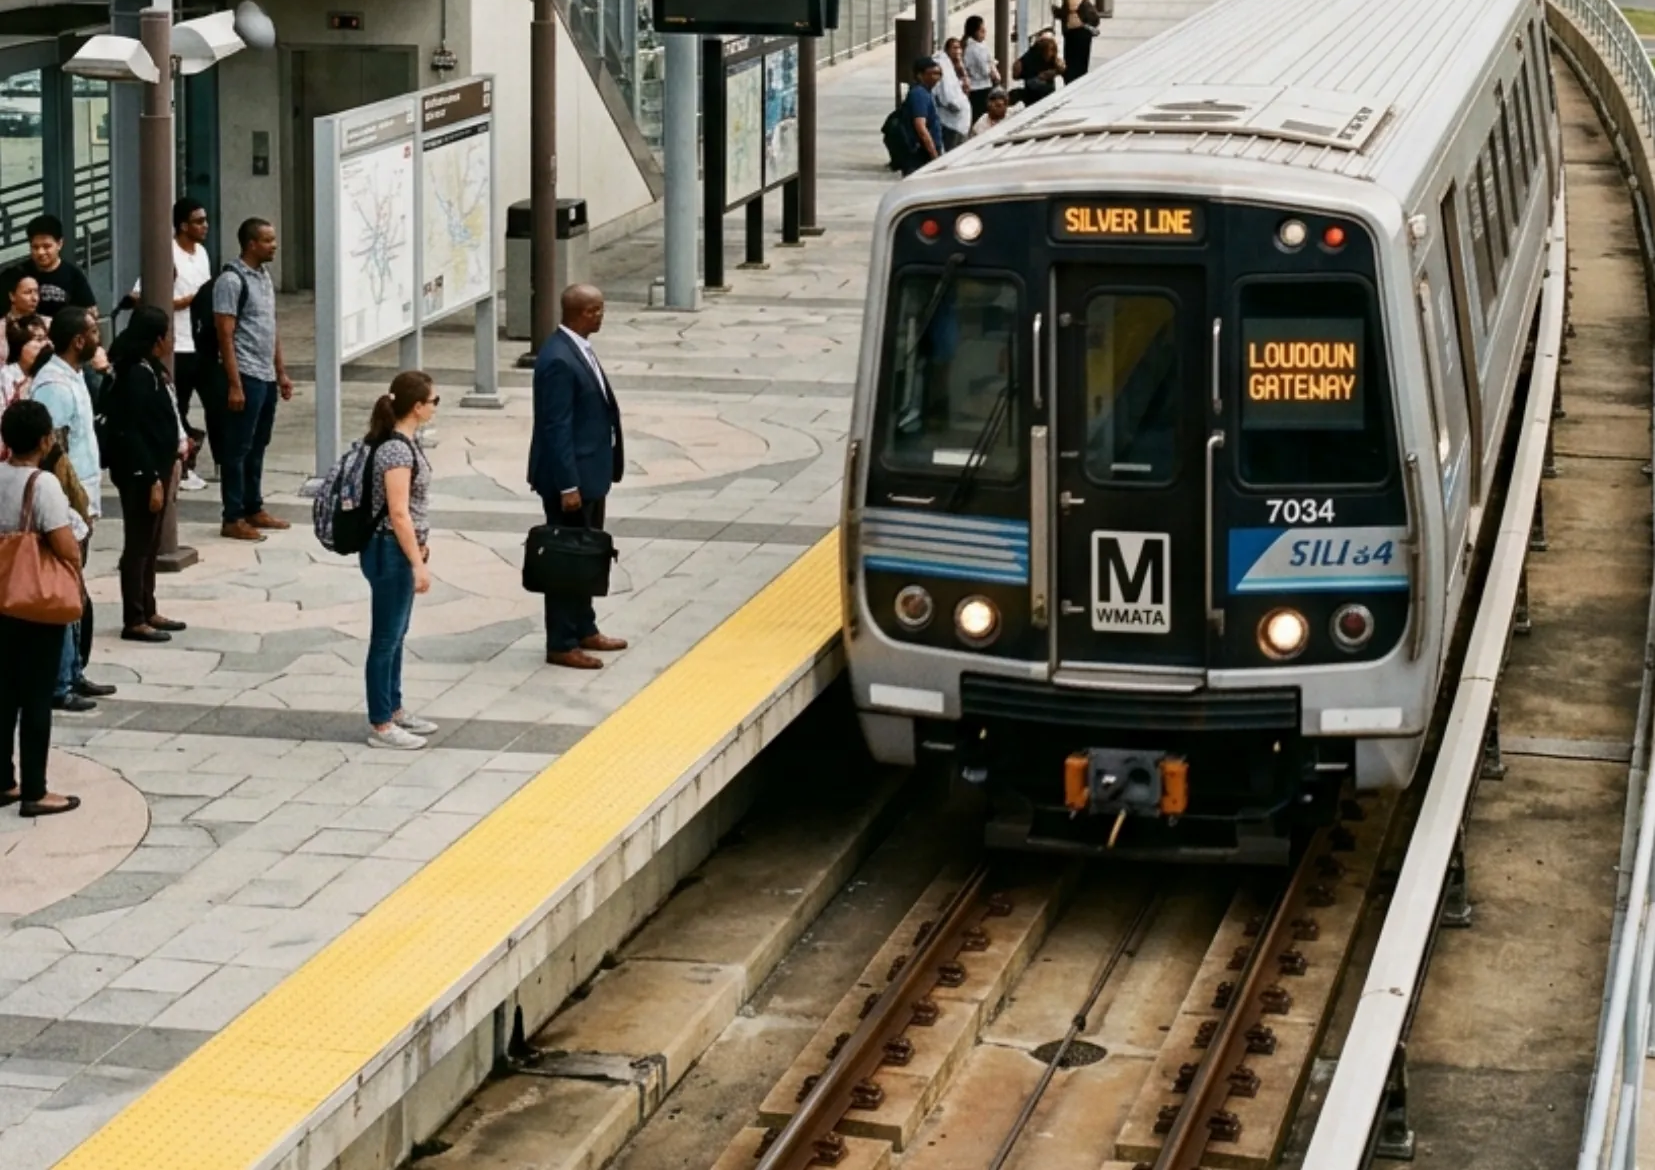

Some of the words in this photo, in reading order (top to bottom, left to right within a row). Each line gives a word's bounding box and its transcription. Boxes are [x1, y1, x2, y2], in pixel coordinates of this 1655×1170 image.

[1064, 207, 1138, 233] SILVER
[1143, 208, 1193, 234] LINE
[1249, 341, 1355, 369] LOUDOUN
[1266, 498, 1336, 523] 7034
[1097, 536, 1164, 605] M
[1096, 608, 1166, 626] WMATA
